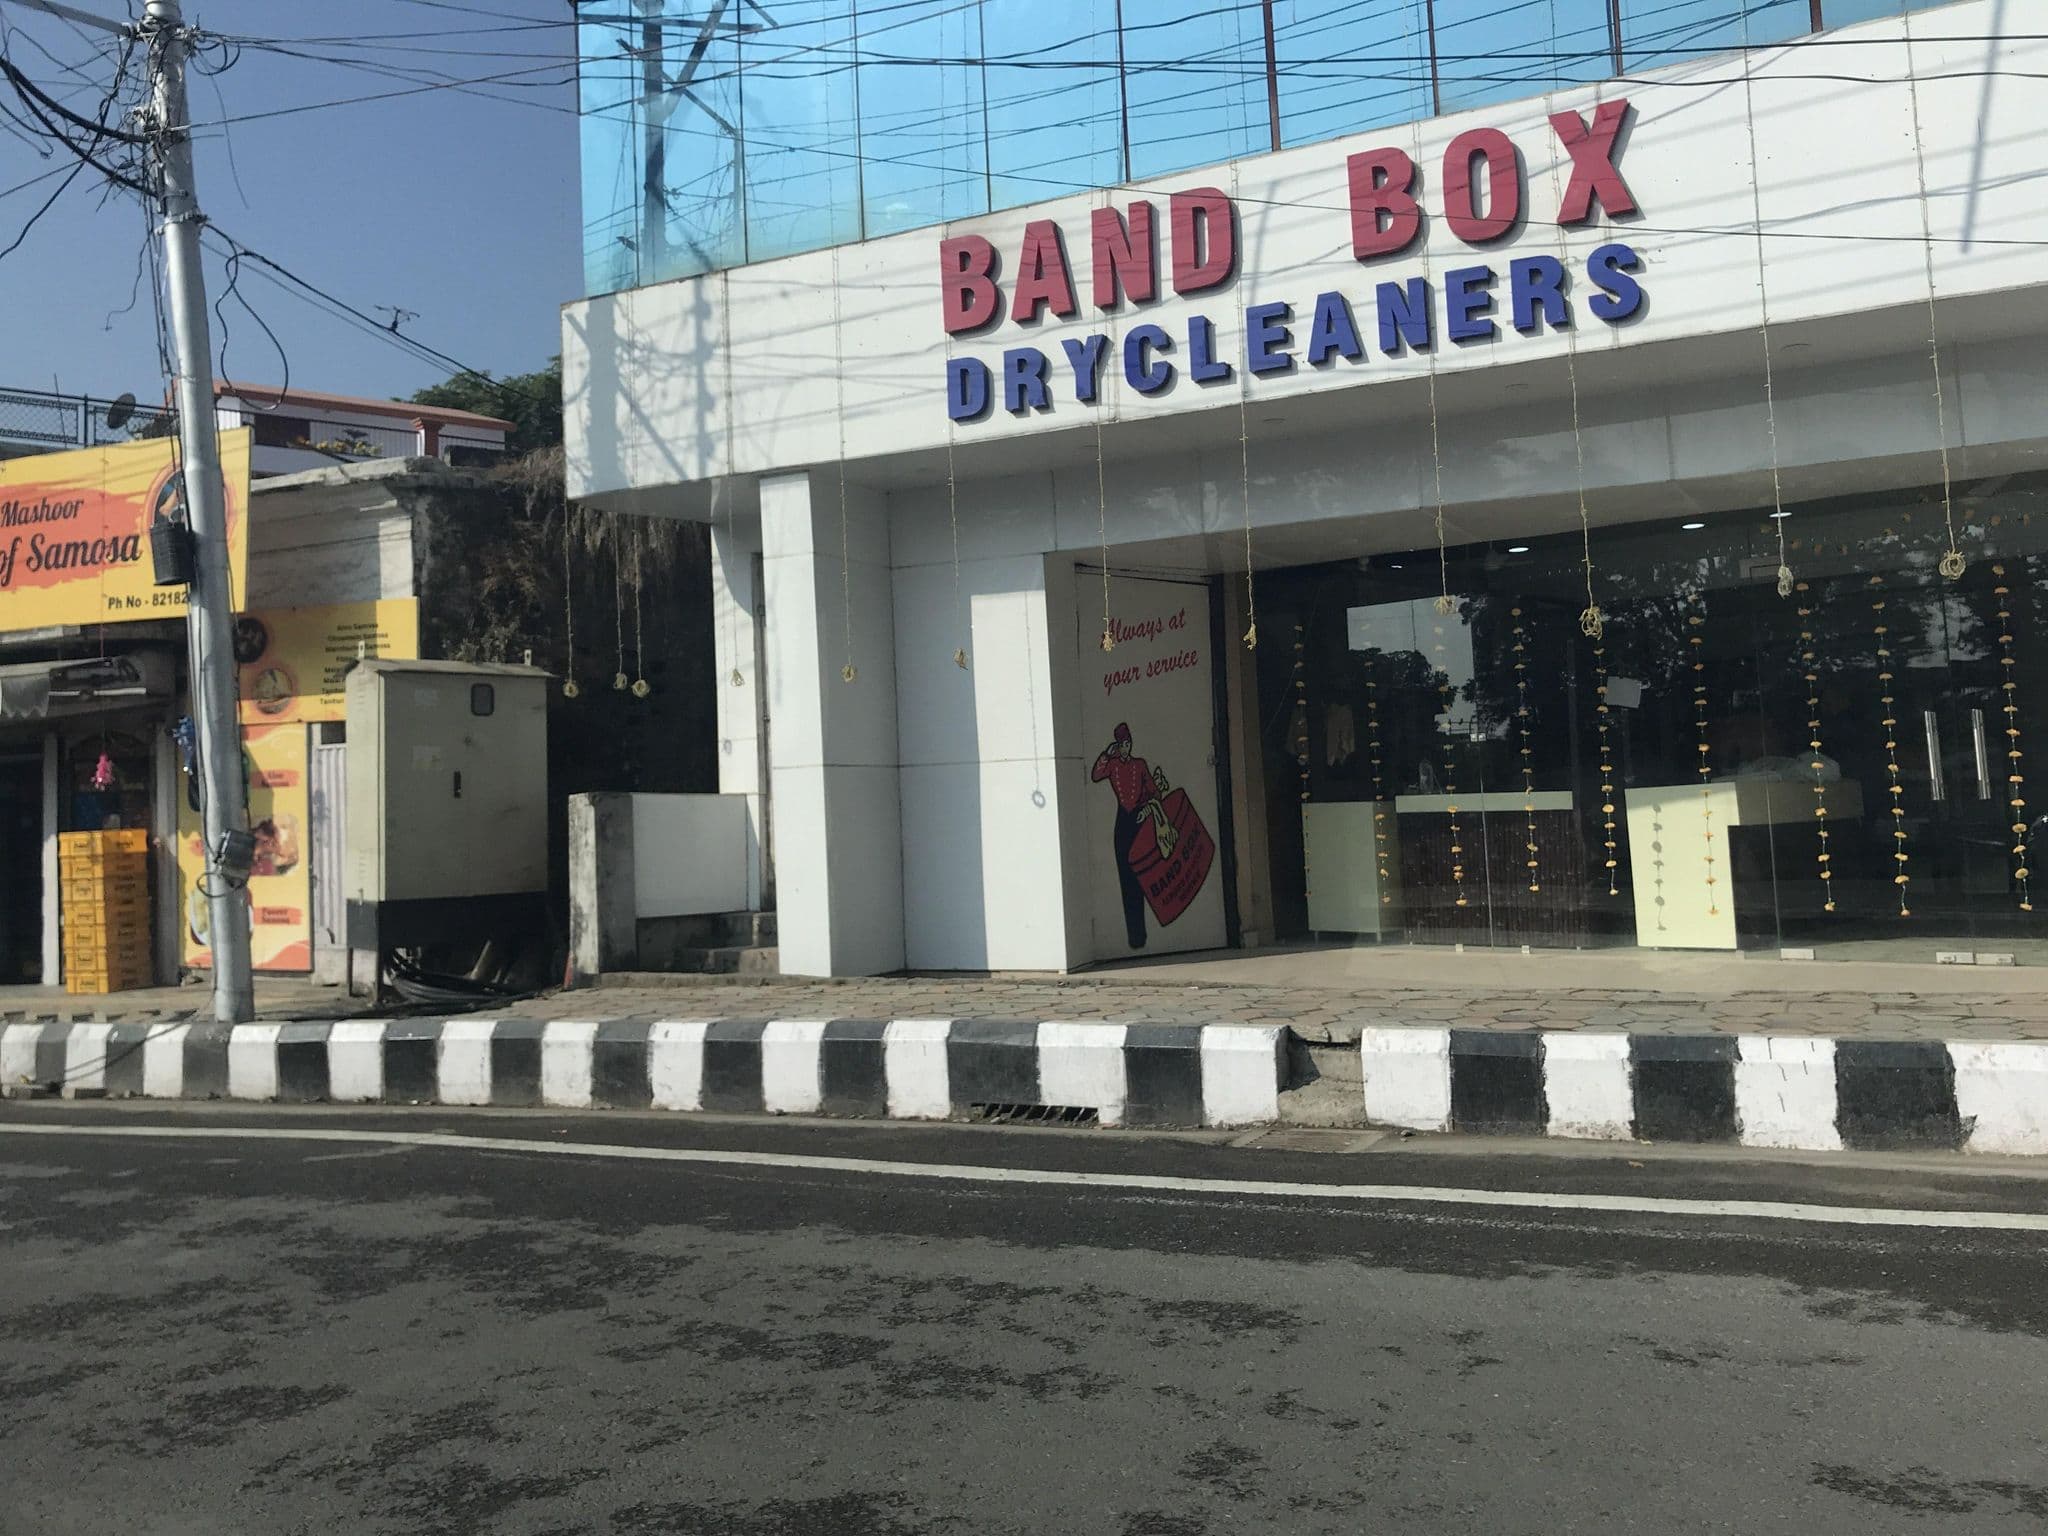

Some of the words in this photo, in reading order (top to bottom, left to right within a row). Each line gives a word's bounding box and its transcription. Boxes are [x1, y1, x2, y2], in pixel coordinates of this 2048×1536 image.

[940, 186, 1238, 335] BAND
[1347, 98, 1640, 262] BOX
[947, 244, 1645, 422] DRYCLEANERS
[0, 496, 84, 527] Mashoor
[26, 533, 143, 572] Samosa
[108, 596, 122, 610] Ph
[126, 596, 141, 608] No
[1100, 617, 1164, 649] Always
[1168, 608, 1186, 630] at
[1104, 666, 1140, 696] your
[1146, 650, 1199, 678] service
[1150, 860, 1182, 897] BAND
